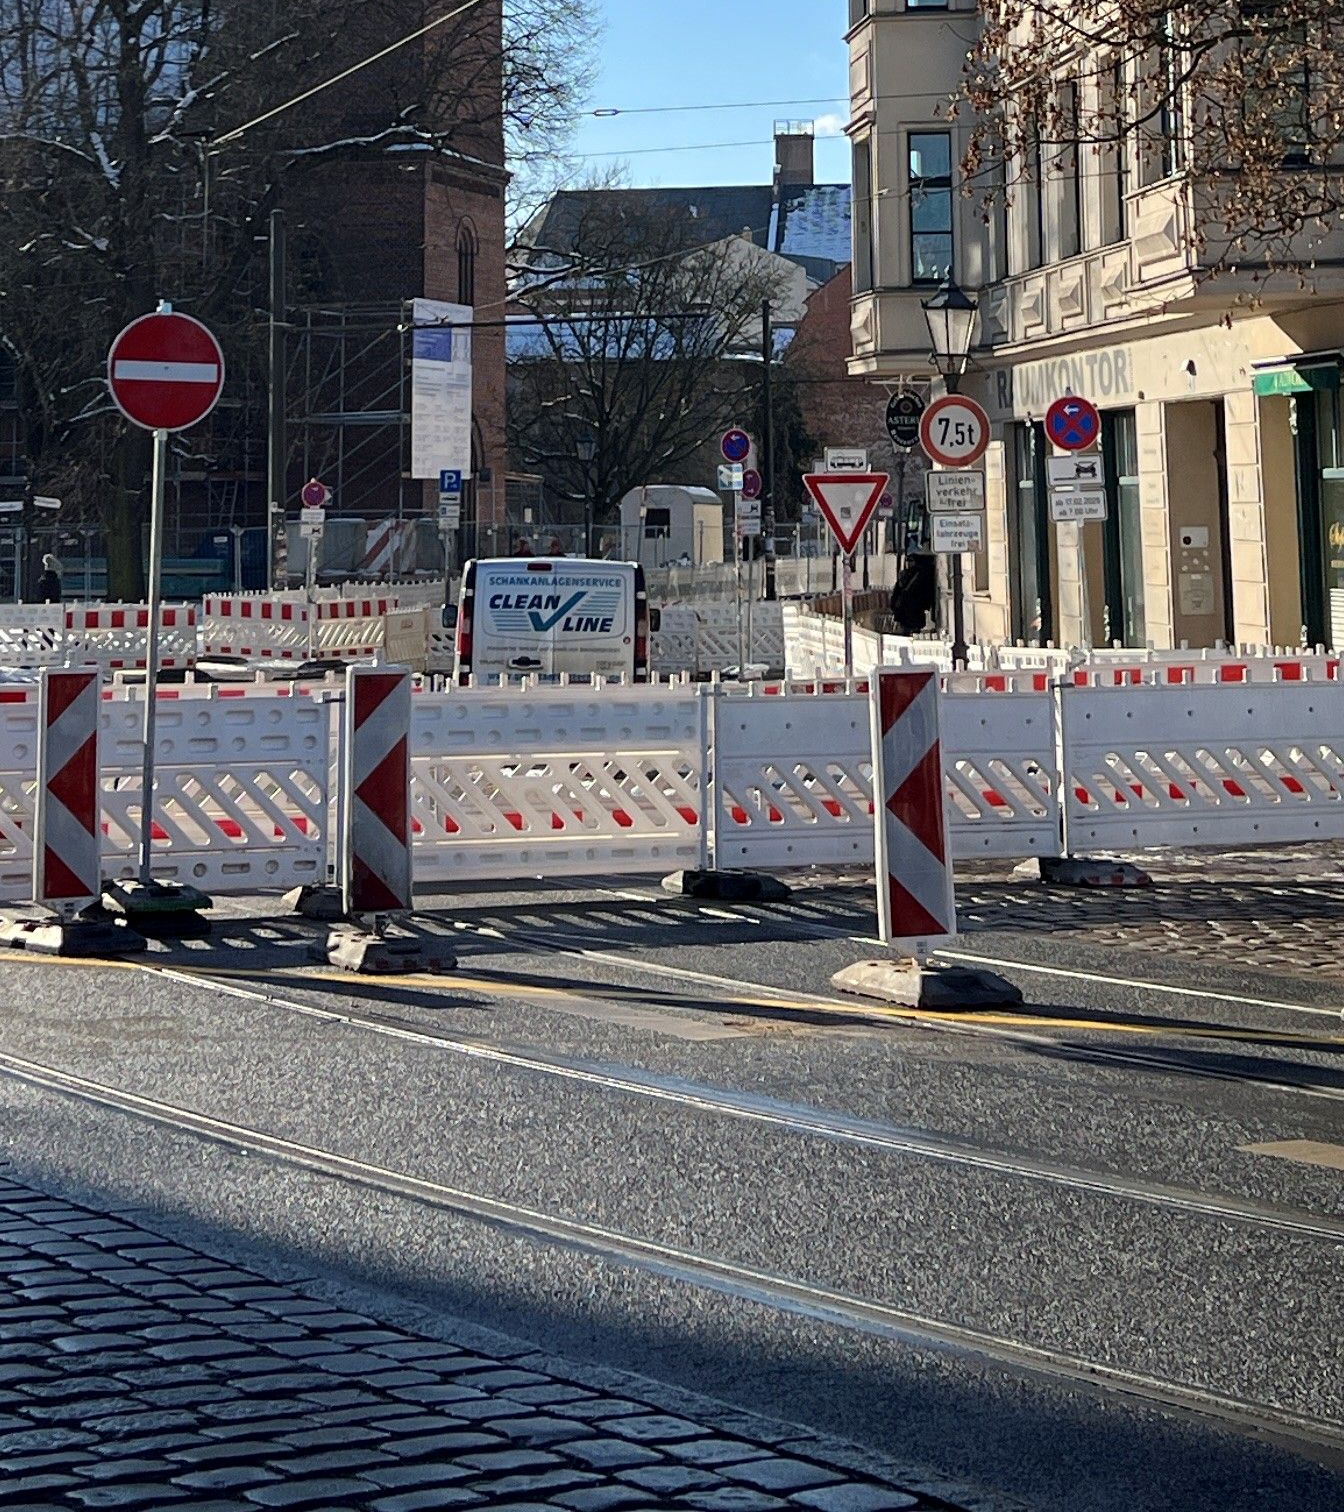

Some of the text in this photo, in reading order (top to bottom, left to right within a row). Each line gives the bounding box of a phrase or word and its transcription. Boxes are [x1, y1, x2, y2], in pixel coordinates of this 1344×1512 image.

[996, 349, 1129, 409] RUMKONTOR
[489, 576, 622, 588] SCHANKANLAGENSERVICE
[489, 594, 561, 610] CLEAN
[562, 617, 613, 633] LINE
